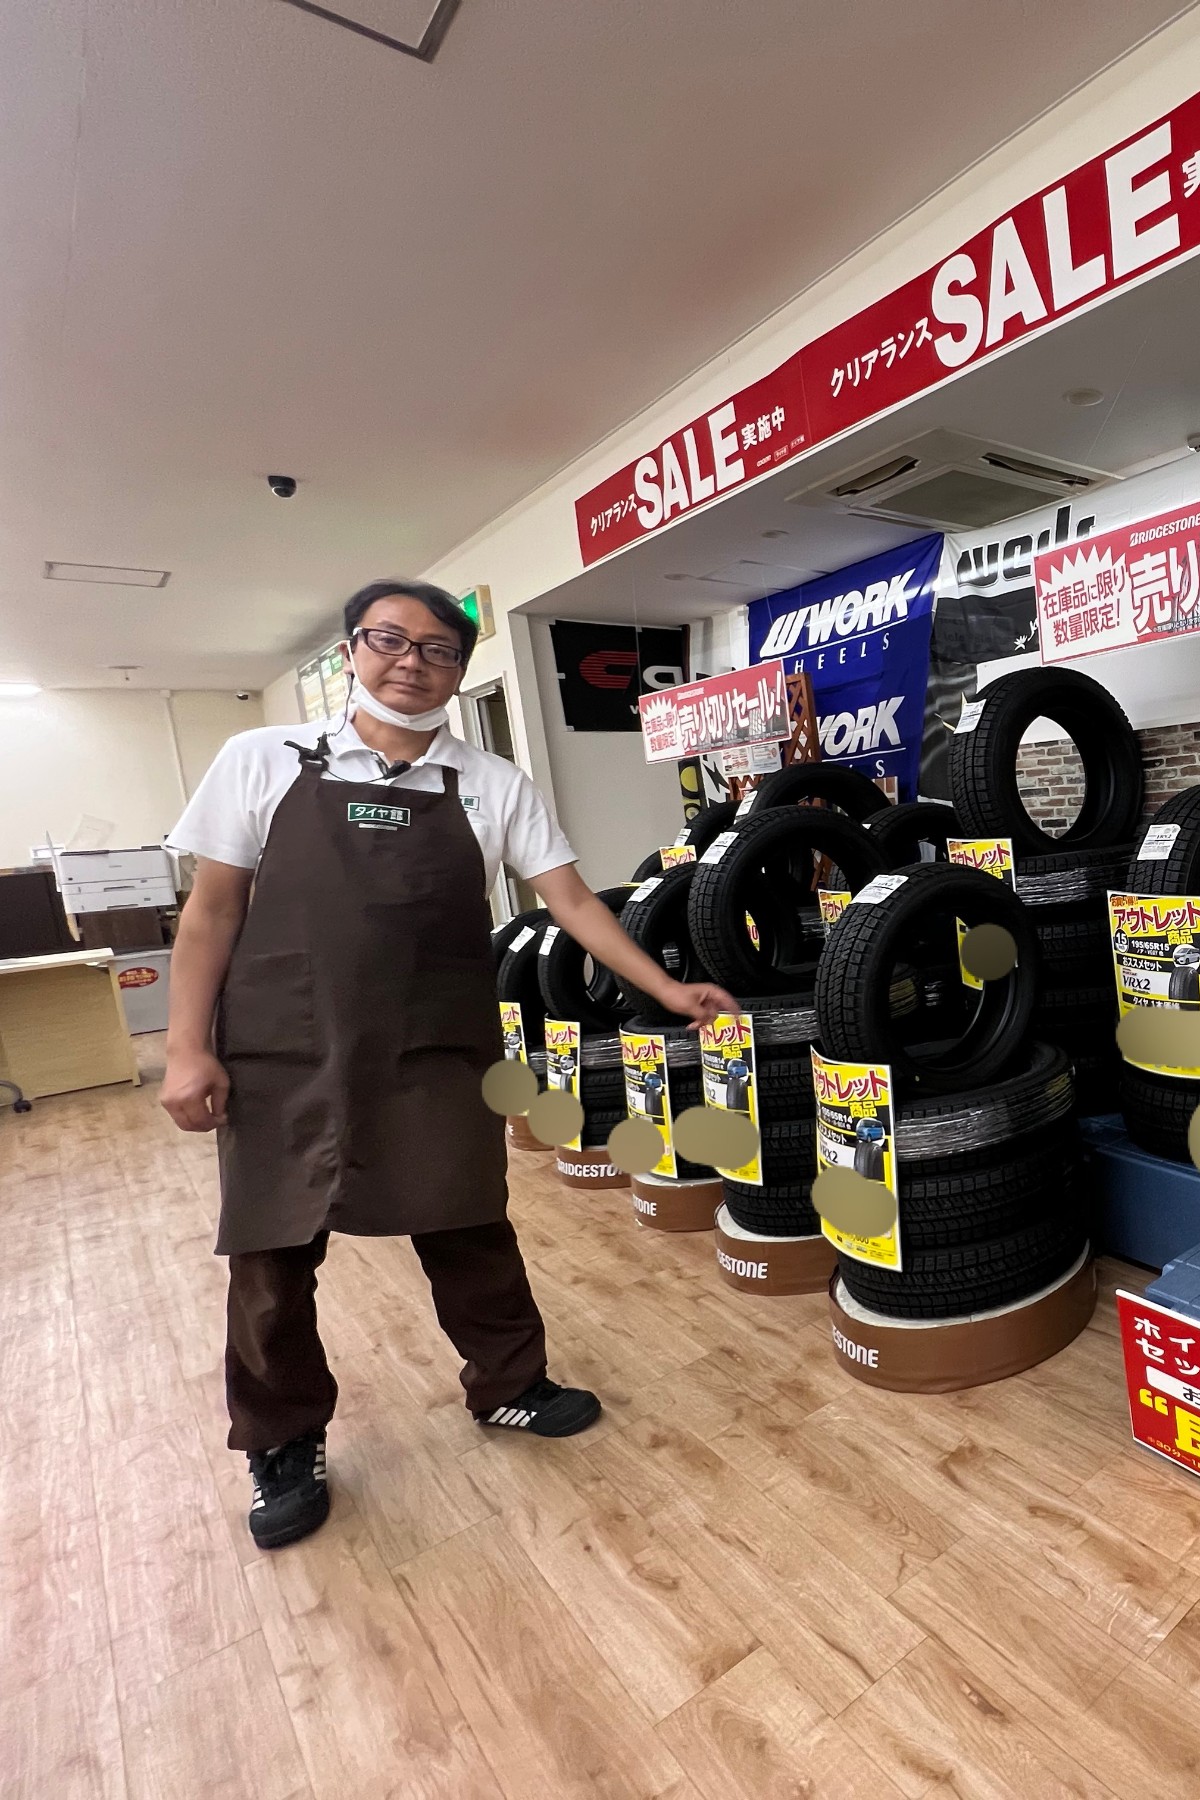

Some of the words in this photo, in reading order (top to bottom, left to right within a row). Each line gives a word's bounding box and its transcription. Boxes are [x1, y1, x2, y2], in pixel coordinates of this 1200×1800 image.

[830, 315, 934, 398] クリアランス
[930, 123, 1181, 369] SALE
[590, 493, 638, 537] クリアランス
[634, 401, 746, 530] SALE
[741, 405, 786, 450] 実施中
[804, 568, 916, 647] WORK
[1042, 564, 1126, 620] 在庫品に限り
[794, 632, 890, 675] HEELS
[1116, 932, 1127, 945] 15
[1166, 929, 1194, 945] 商品
[1122, 975, 1151, 991] VRX2
[848, 1101, 878, 1118] 商品
[556, 1156, 625, 1179] BRIDGESTO
